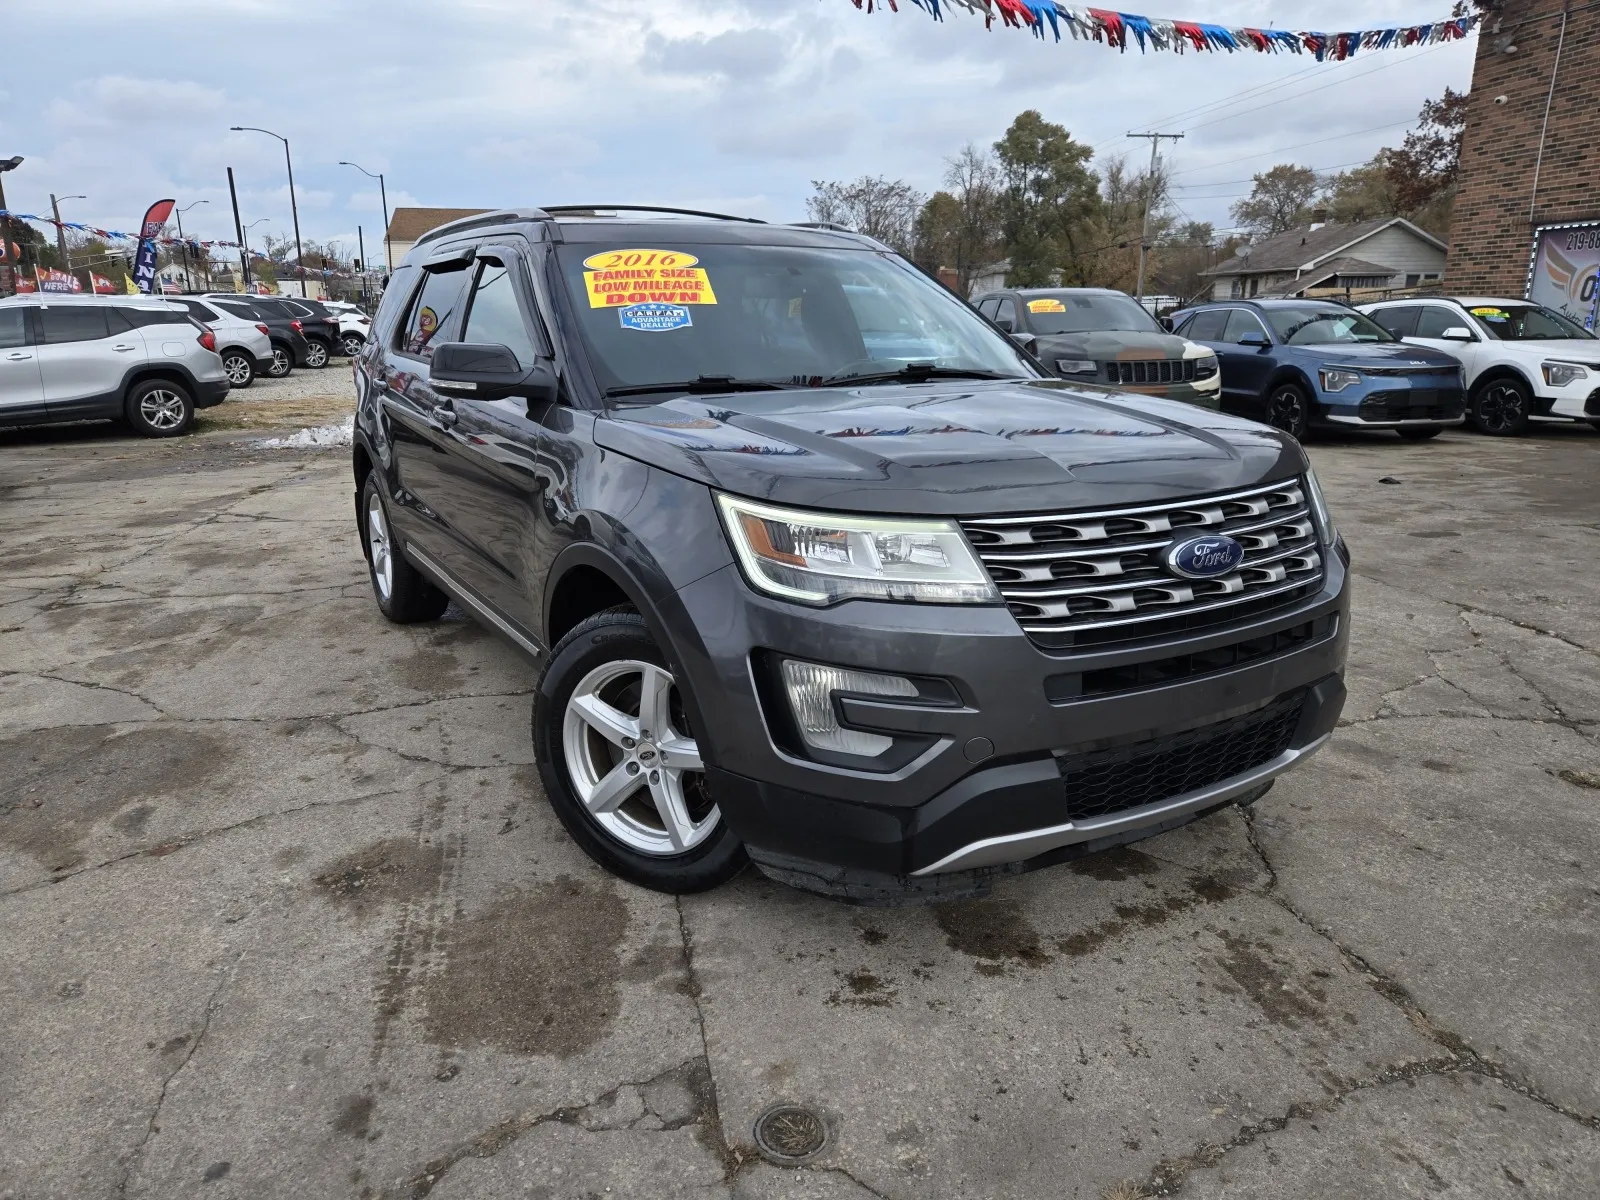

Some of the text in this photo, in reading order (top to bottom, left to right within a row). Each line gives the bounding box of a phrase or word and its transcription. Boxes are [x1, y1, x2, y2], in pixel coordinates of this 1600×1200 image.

[605, 253, 677, 268] 2016
[593, 268, 697, 281] FAMILY SIZE
[44, 281, 69, 291] HERE
[594, 280, 704, 293] LOW MILEAGE
[605, 292, 700, 305] DOWN
[631, 316, 681, 324] ADVANTAGE
[1192, 543, 1232, 569] Ford
